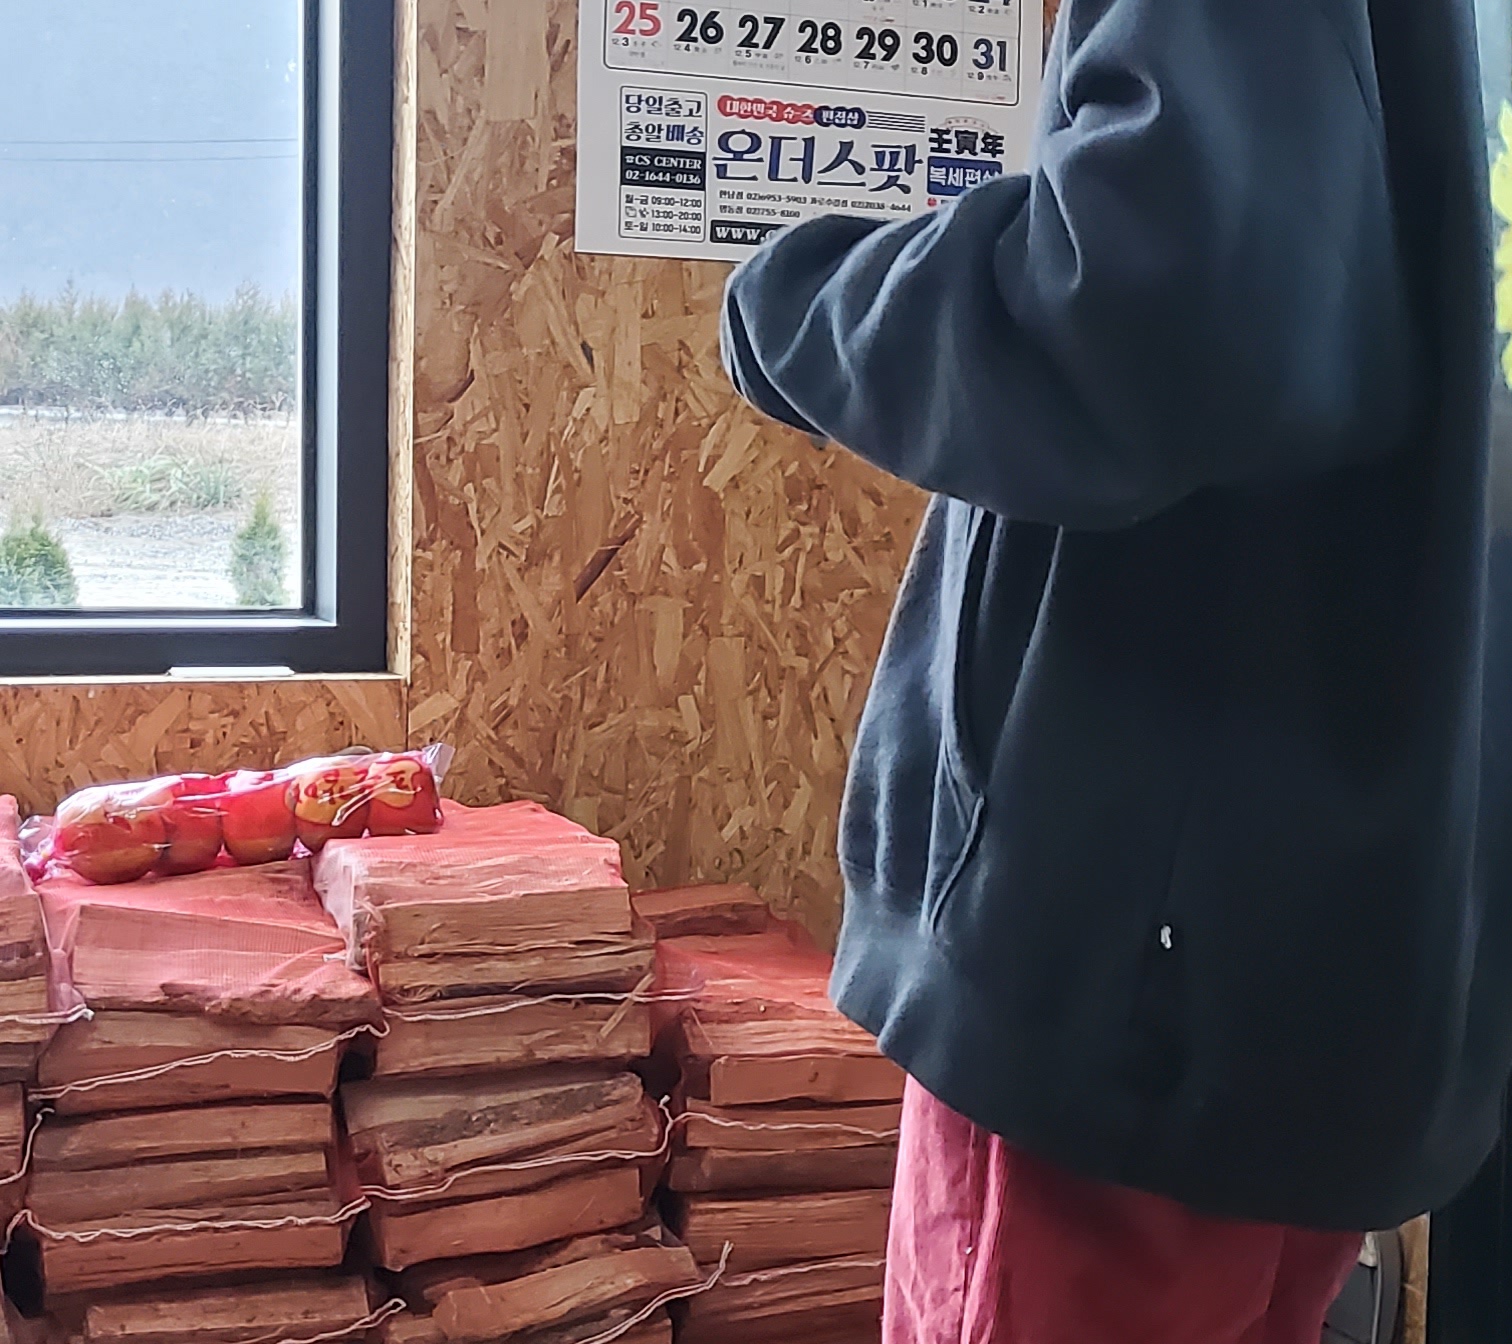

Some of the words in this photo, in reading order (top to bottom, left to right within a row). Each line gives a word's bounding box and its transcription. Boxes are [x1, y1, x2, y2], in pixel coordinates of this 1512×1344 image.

[613, 0, 661, 36] 25
[675, 8, 724, 44] 26
[736, 14, 786, 50] 27
[797, 19, 842, 55] 28
[854, 26, 901, 62] 29
[912, 31, 958, 67] 30
[972, 38, 1007, 72] 31
[624, 94, 702, 118] 당일출고
[726, 100, 778, 118] 대한민국
[624, 122, 704, 145] 총알배송
[929, 128, 1004, 158] 壬寅年
[635, 155, 651, 166] CS
[654, 156, 702, 169] CENTER
[712, 128, 924, 194] 온더스팟
[625, 170, 701, 184] 02-1644-0136
[624, 221, 648, 232] 토-일
